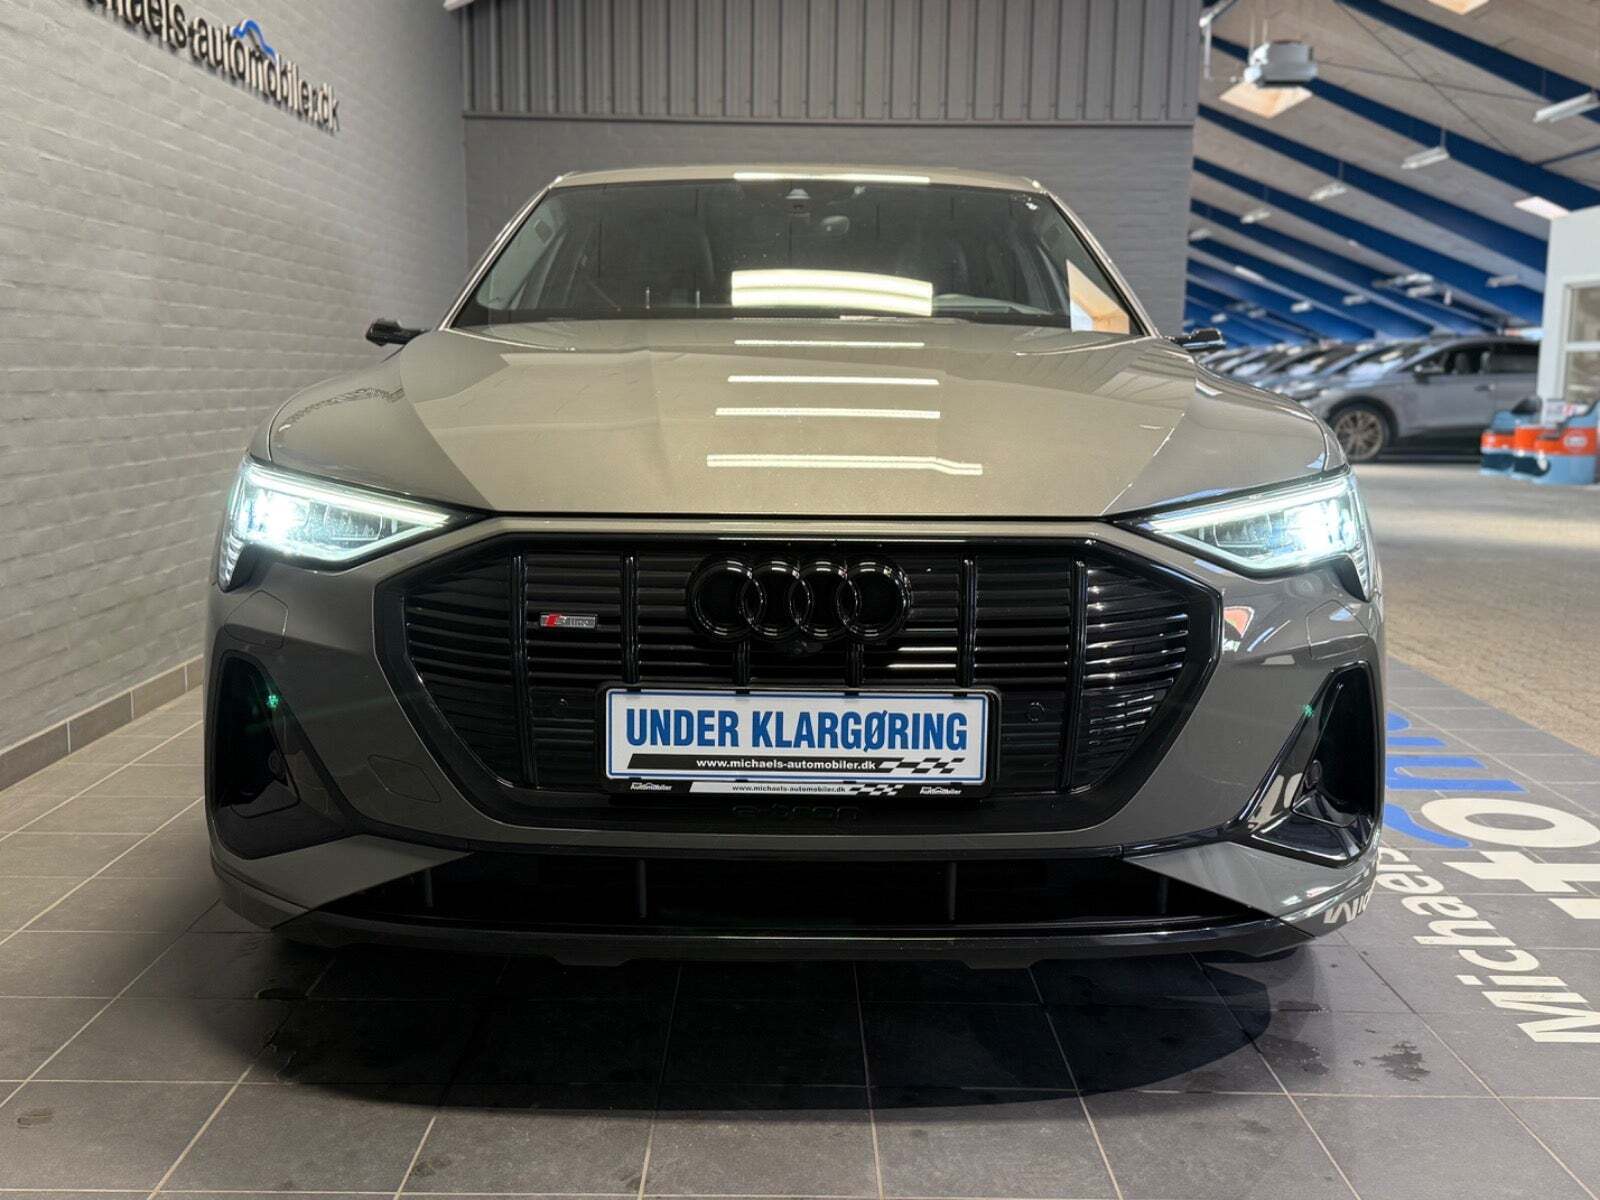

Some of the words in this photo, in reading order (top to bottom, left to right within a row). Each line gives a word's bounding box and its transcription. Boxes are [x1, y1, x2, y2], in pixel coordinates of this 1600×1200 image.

[626, 708, 739, 747] UNDER
[752, 710, 968, 753] KLARGØRING
[696, 759, 876, 771] www.michaels-automobiler.dk
[732, 784, 846, 793] www.michaels-automobiler.dk
